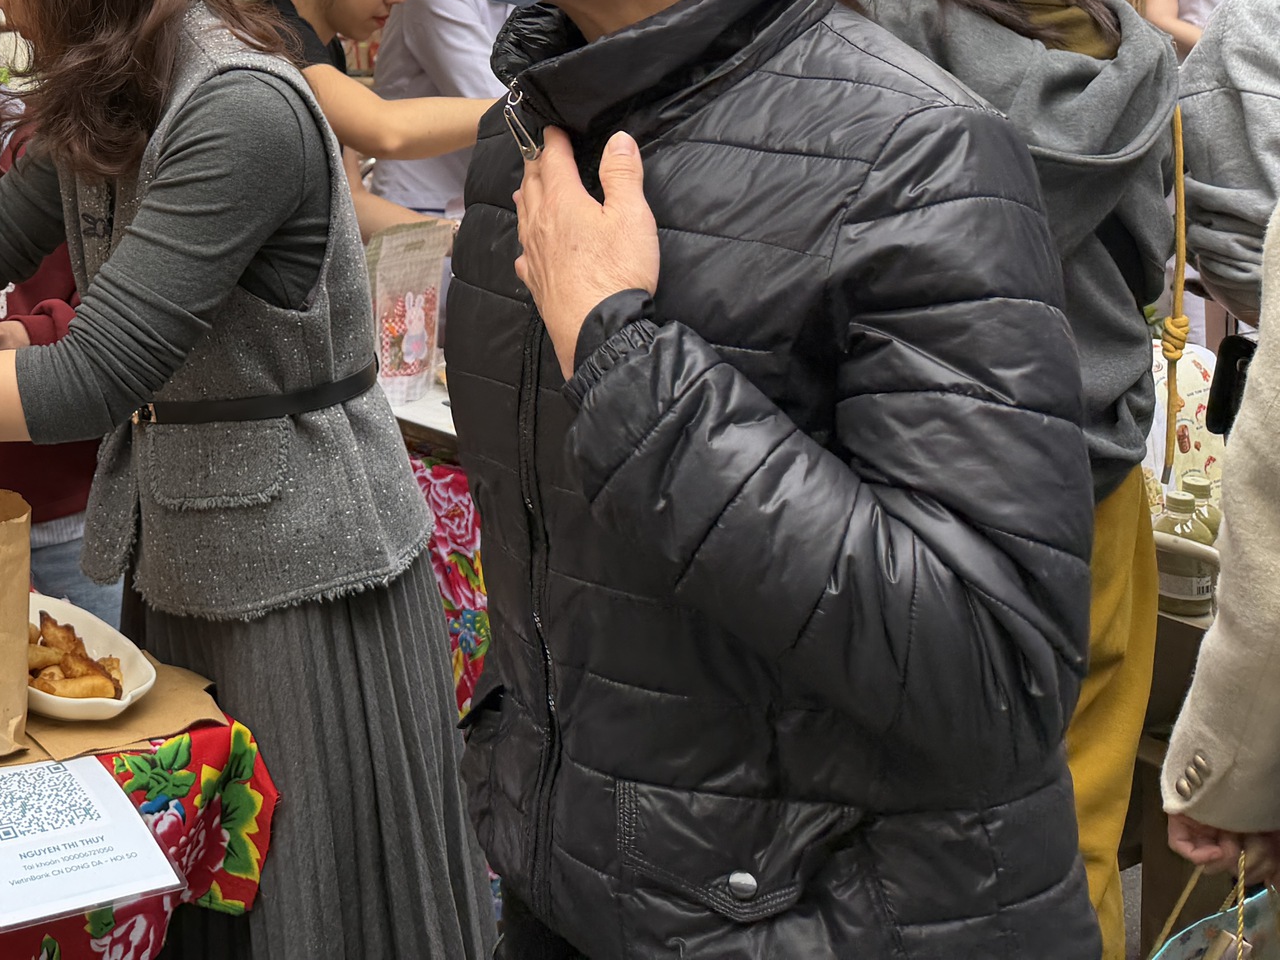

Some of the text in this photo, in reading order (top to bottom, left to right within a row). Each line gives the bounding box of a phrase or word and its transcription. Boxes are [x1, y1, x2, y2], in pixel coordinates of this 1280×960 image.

[19, 834, 105, 860] NGUYEN THI THUY
[9, 872, 51, 886] VietinBank
[65, 862, 90, 874] DONG
